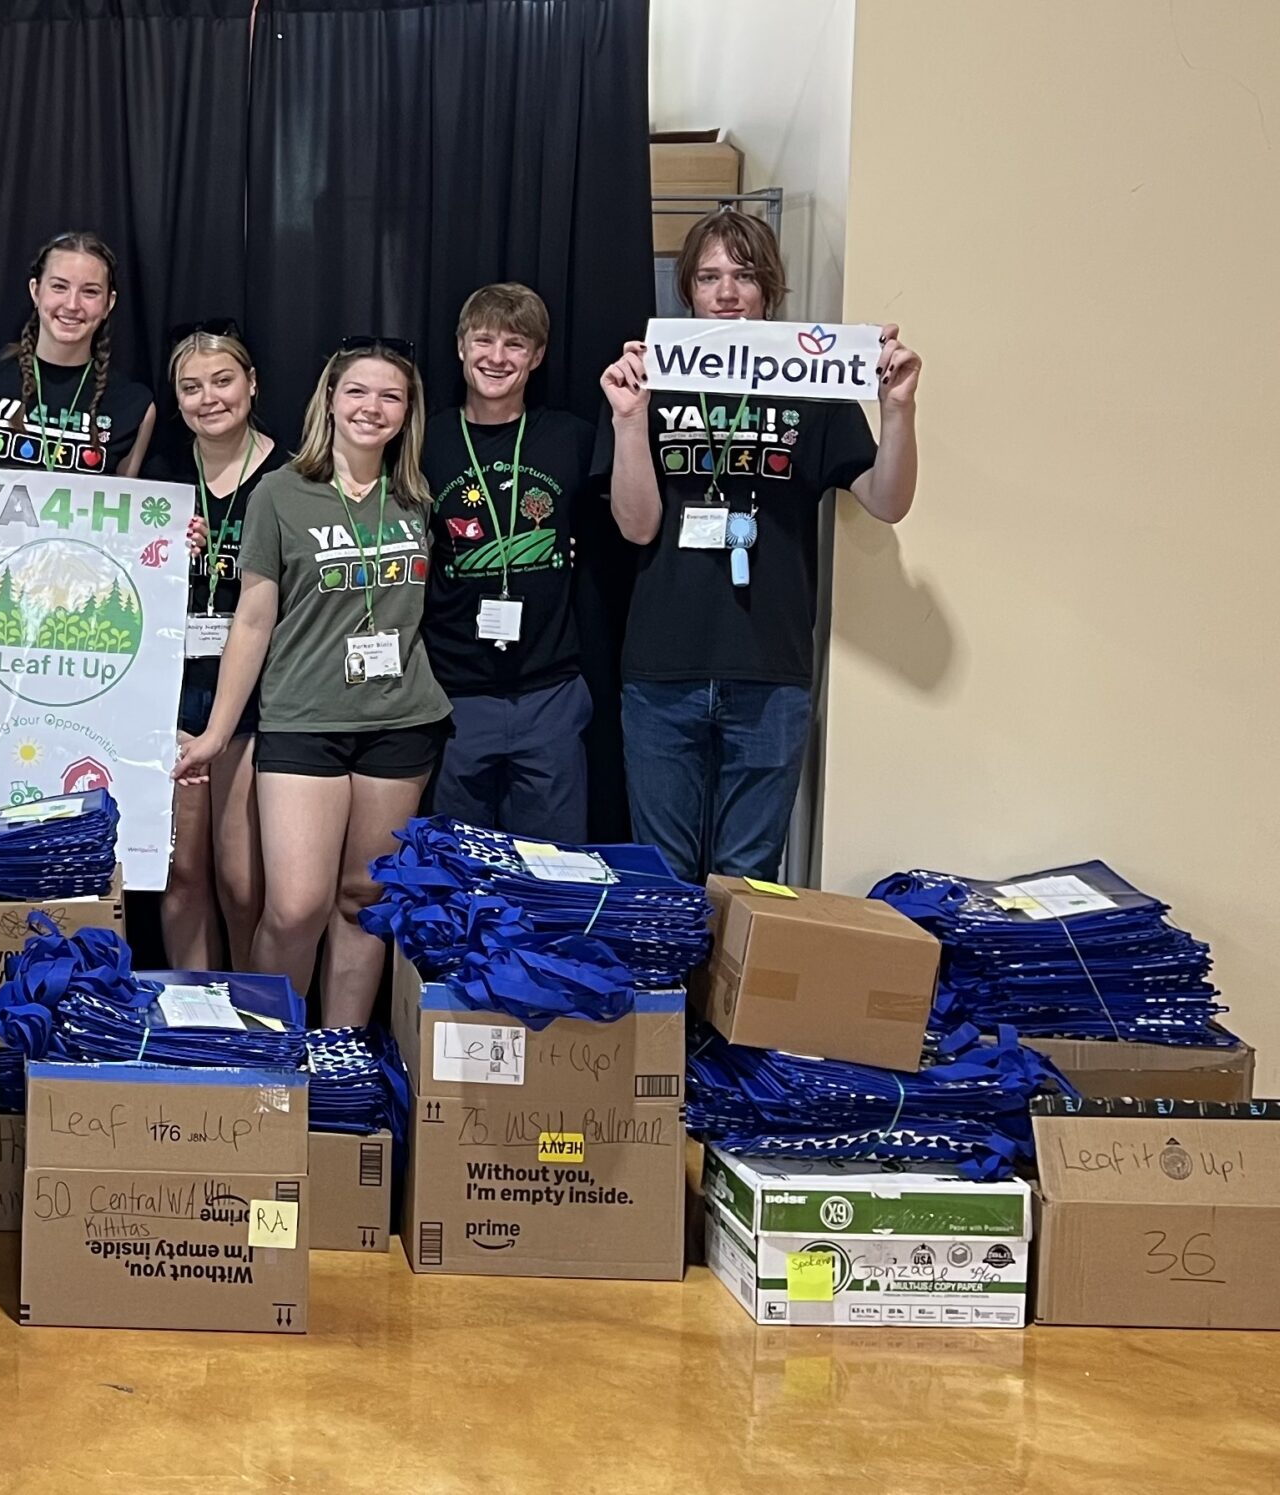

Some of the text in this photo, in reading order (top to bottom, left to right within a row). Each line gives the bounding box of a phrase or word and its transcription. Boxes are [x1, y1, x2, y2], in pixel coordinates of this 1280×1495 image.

[654, 344, 866, 390] Wellpoint
[657, 405, 777, 432] YA4-H!
[58, 655, 75, 677] It
[83, 657, 117, 685] Up
[443, 1022, 524, 1074] Leaf
[49, 1094, 128, 1149] Leaf
[150, 1124, 181, 1142] 176
[458, 1106, 490, 1142] 75
[506, 1109, 566, 1145] WSU
[539, 1141, 583, 1155] HEAVY
[1058, 1137, 1246, 1183] Leaf it Up!
[467, 1163, 595, 1186] Without you,
[33, 1176, 71, 1219] 50
[90, 1182, 163, 1214] Central
[466, 1183, 634, 1206] I'm empty inside.
[84, 1213, 151, 1238] Kittitas
[466, 1220, 521, 1239] prime
[85, 1240, 152, 1255] inside.
[154, 1240, 219, 1259] empty
[913, 1255, 932, 1265] USA
[1144, 1230, 1216, 1277] 36
[124, 1259, 253, 1284] Without you,
[934, 1282, 957, 1292] COPY
[957, 1283, 983, 1292] PAPER
